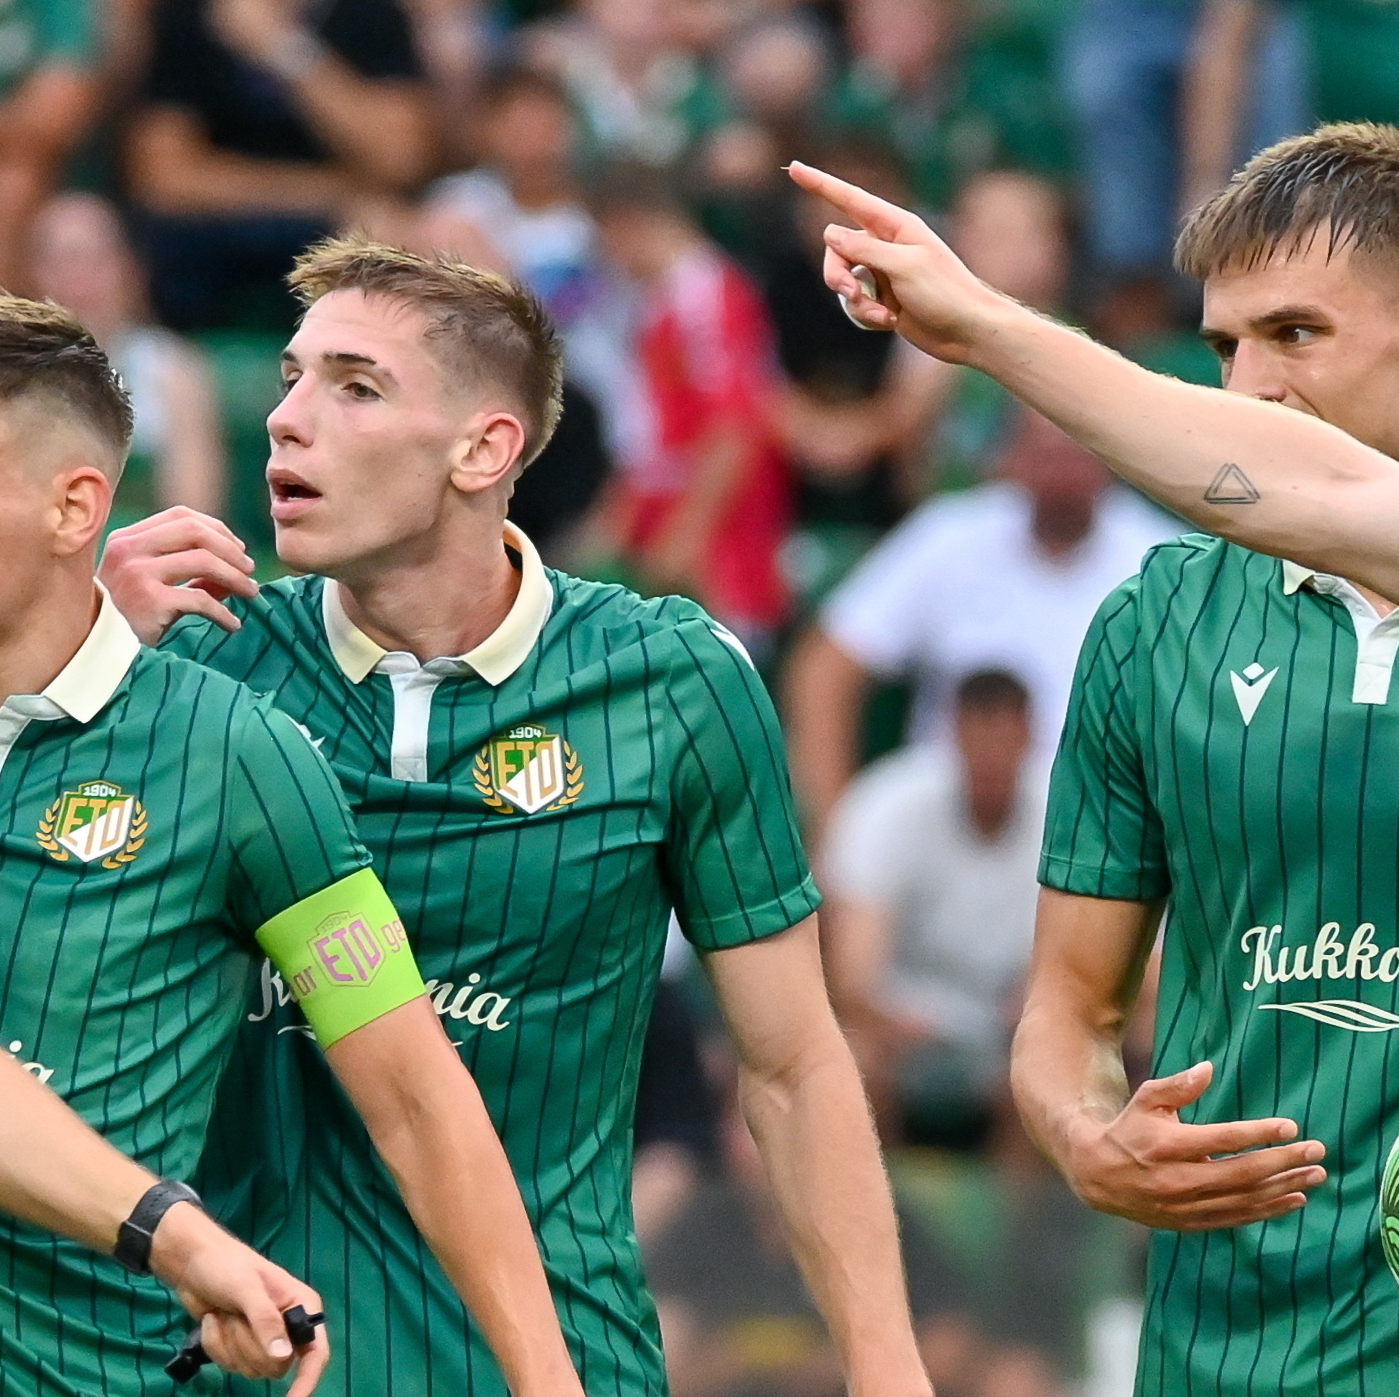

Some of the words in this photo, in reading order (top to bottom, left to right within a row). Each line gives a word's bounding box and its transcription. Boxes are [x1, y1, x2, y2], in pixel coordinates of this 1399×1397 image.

[508, 727, 542, 739] 1904
[83, 784, 116, 797] 1904
[497, 741, 557, 806] ETO
[63, 797, 126, 855] ETO
[315, 919, 381, 981] ETO
